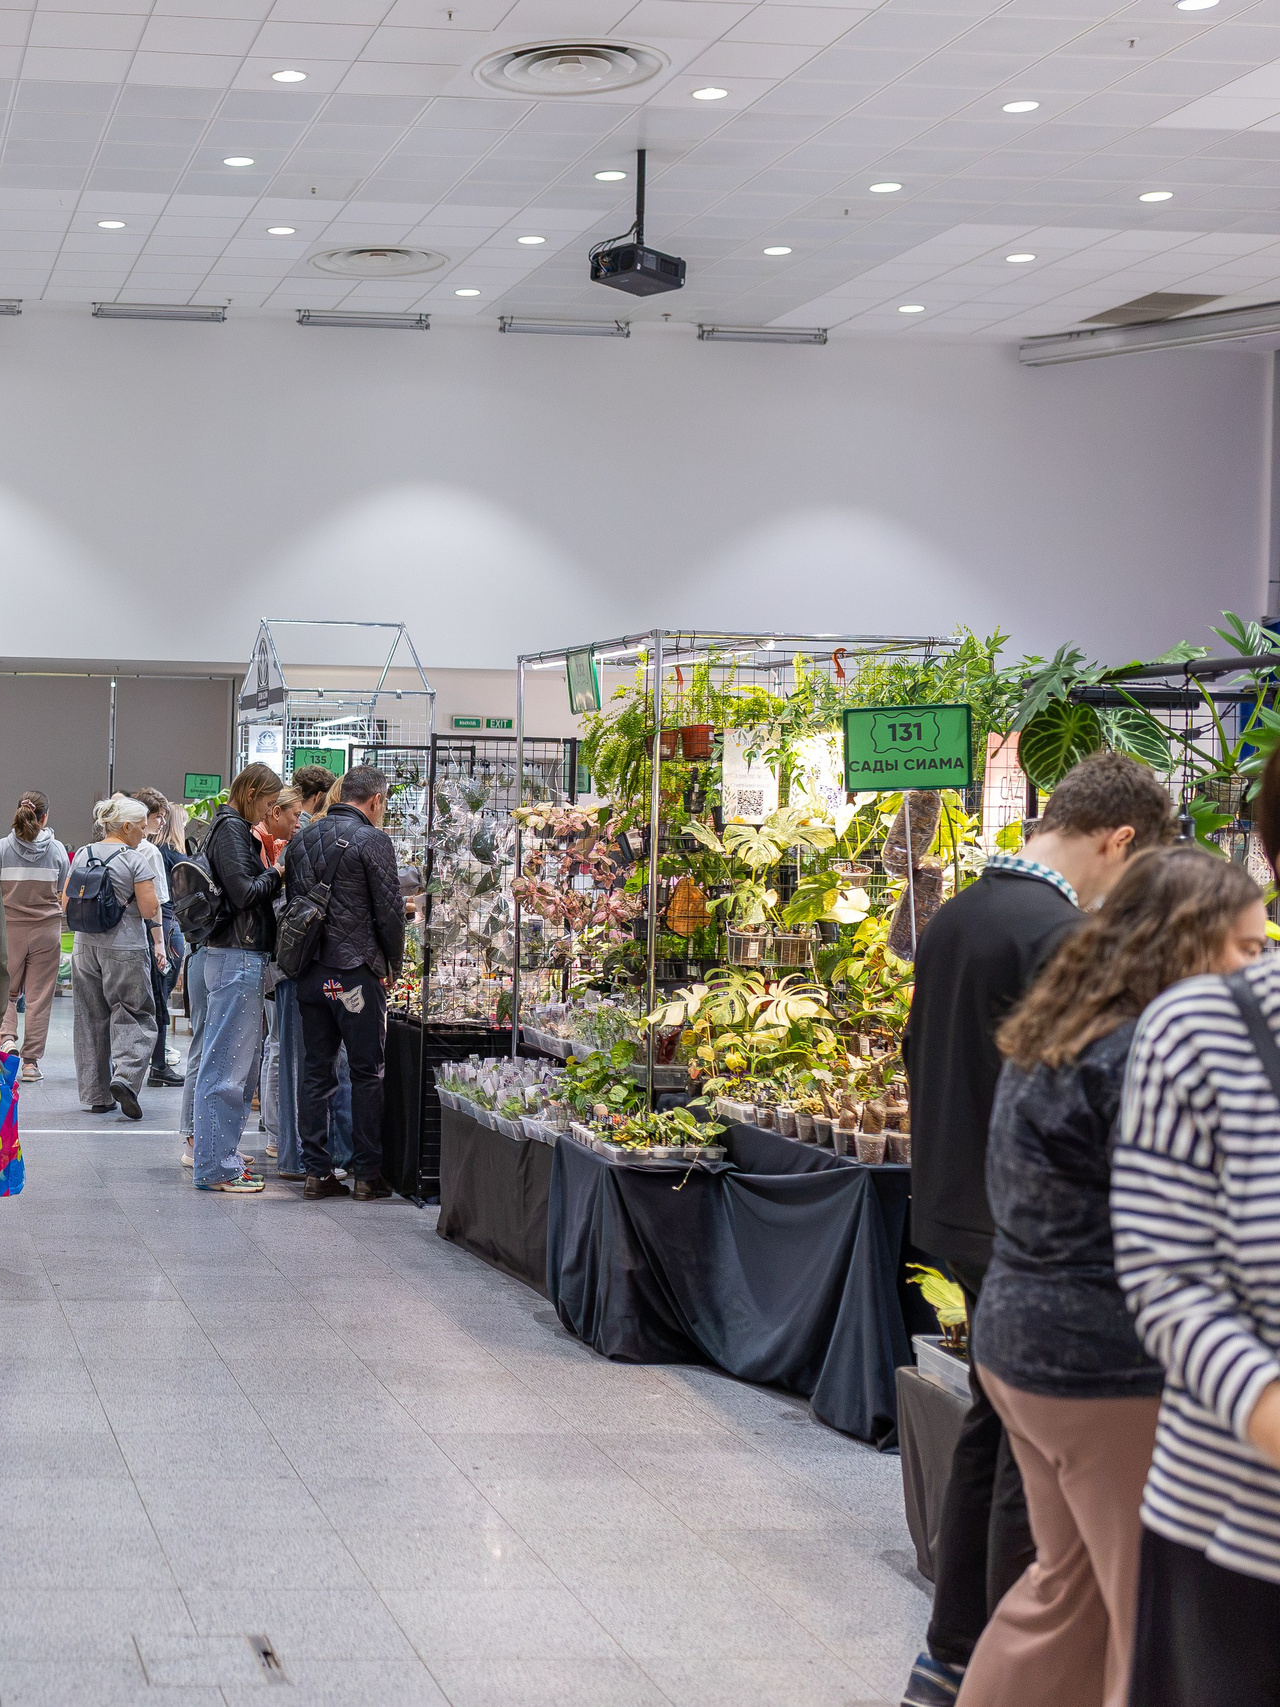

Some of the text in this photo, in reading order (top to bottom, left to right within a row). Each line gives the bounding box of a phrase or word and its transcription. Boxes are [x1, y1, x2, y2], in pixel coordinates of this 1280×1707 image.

[490, 719, 508, 728] EXIT
[887, 722, 923, 742] 131
[310, 755, 327, 765] 135
[848, 757, 965, 774] САДЫ СИАМА
